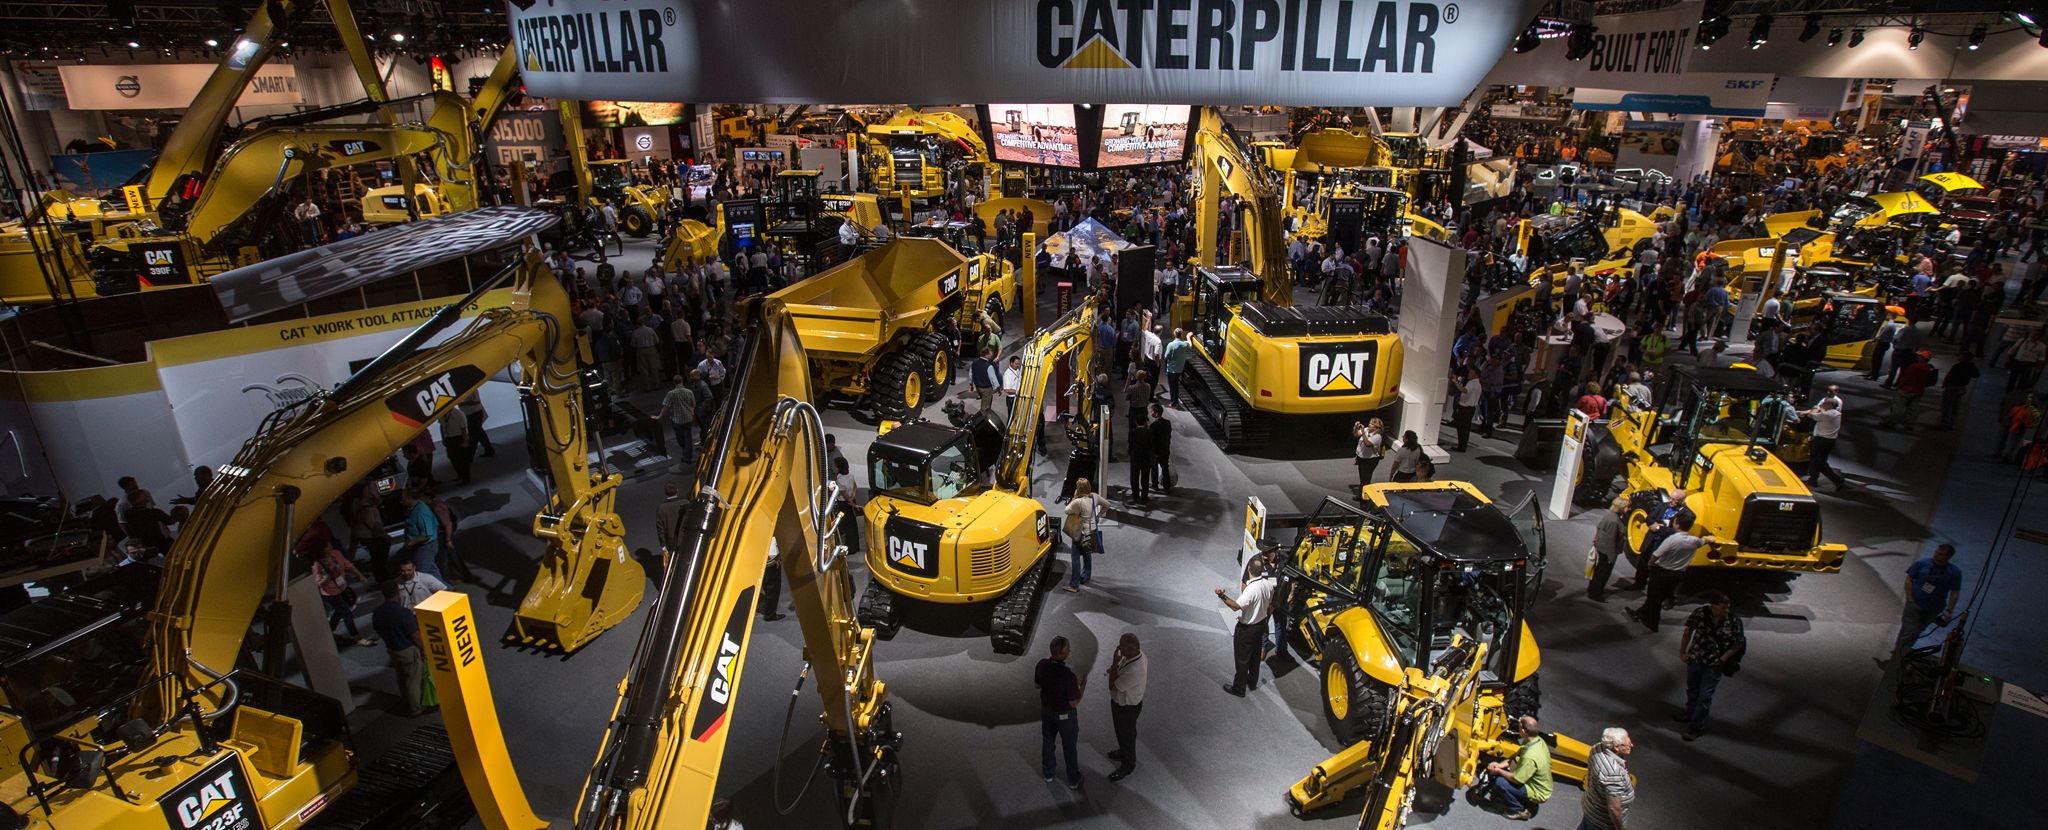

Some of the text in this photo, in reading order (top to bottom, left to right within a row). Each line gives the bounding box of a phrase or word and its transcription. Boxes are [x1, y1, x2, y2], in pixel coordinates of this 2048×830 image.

[1589, 32, 1646, 72] BUILT
[1644, 30, 1676, 74] FOR
[252, 76, 285, 93] SMART
[1725, 80, 1765, 89] SKF
[344, 141, 366, 155] CAT
[1001, 139, 1073, 151] COMPETITIVE ADVANTAGE
[1108, 139, 1180, 152] COMPETITIVE ADVANTAGE
[127, 190, 140, 209] NEW
[145, 250, 173, 265] CAT
[1024, 240, 1032, 259] NEW
[150, 267, 171, 275] 390F
[969, 263, 980, 281] CAT
[312, 320, 354, 336] WORK
[356, 314, 389, 329] TOOL
[1308, 352, 1369, 391] CAT
[417, 372, 456, 417] CAT
[1780, 502, 1794, 511] CAT
[889, 535, 928, 570] CAT
[424, 623, 451, 672] NEW
[452, 615, 475, 667] NEW
[711, 632, 740, 705] CAT
[177, 769, 237, 829] CAT
